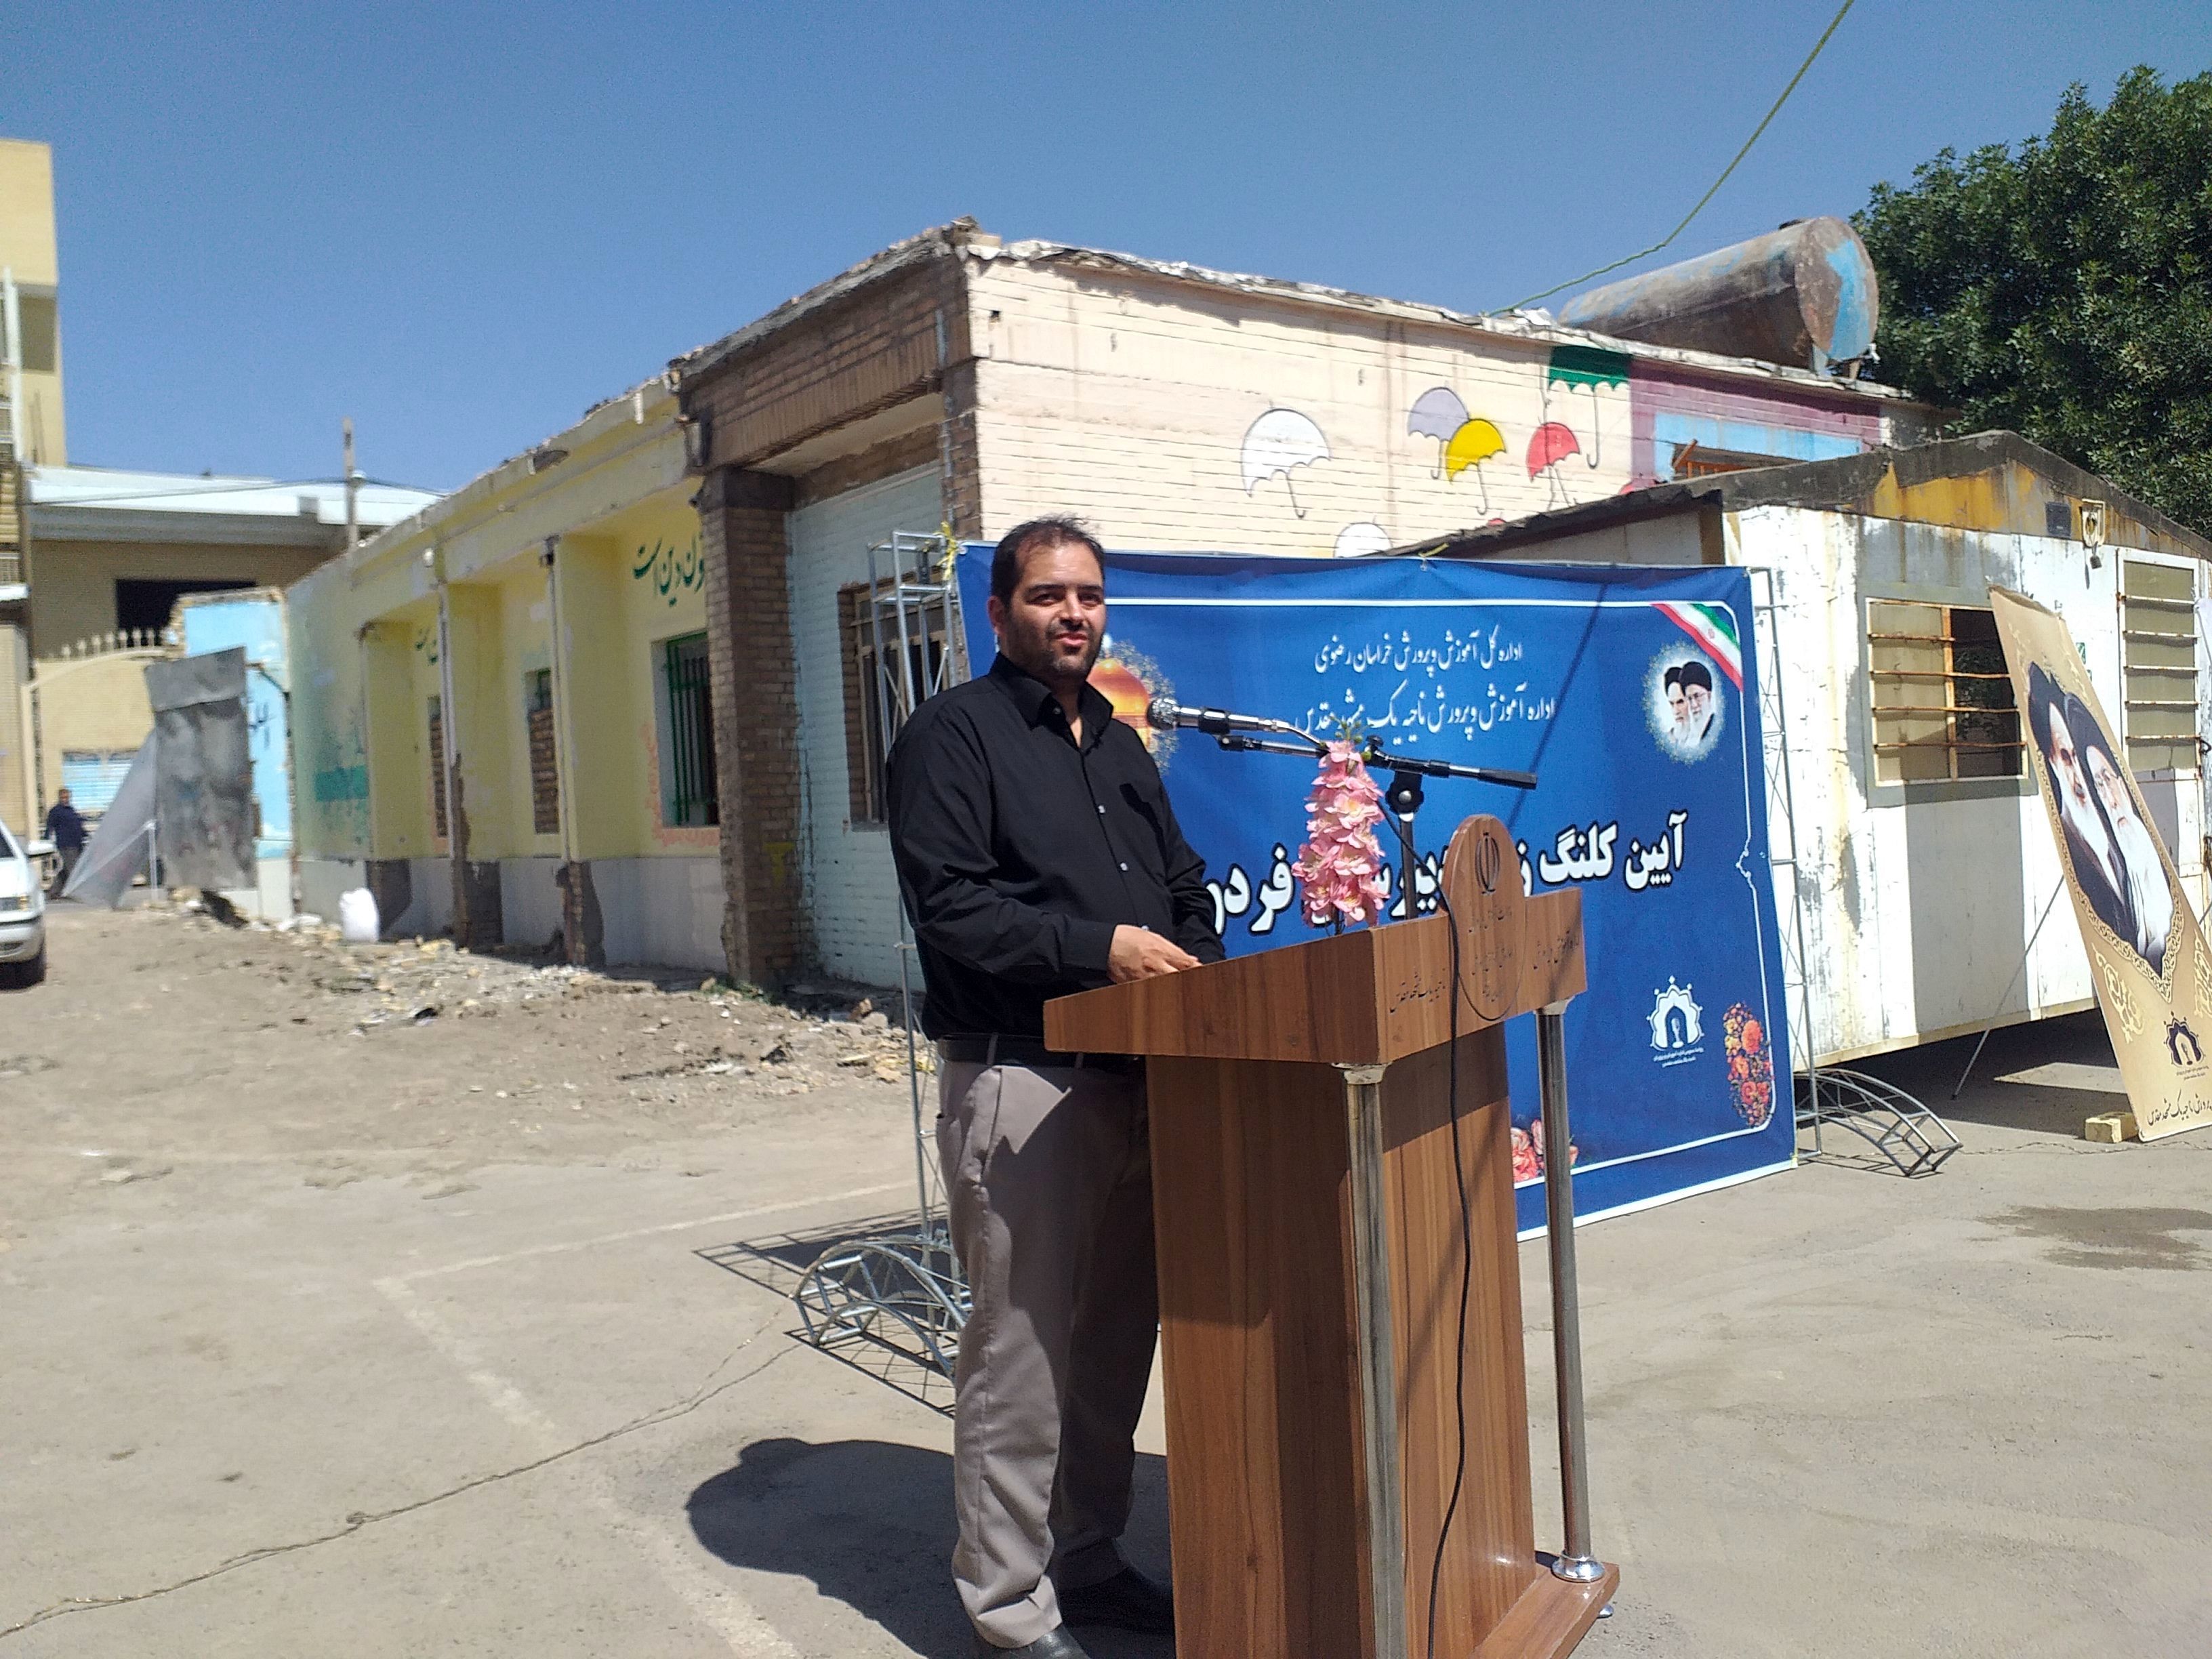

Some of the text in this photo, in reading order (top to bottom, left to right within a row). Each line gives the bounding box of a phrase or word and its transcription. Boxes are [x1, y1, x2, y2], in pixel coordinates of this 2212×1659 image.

[1315, 634, 1351, 673] رضوی
[1353, 632, 1392, 673] خراسان
[1438, 630, 1480, 670] آموزش
[1480, 624, 1500, 670] کل
[1498, 642, 1522, 662] اداره
[1367, 678, 1408, 745] یک
[1402, 691, 1426, 743] ناحیه
[1479, 681, 1528, 731] آموزش
[1528, 696, 1556, 721] اداره
[1538, 821, 1618, 884] کلنگ
[1624, 810, 1689, 891] آیین
